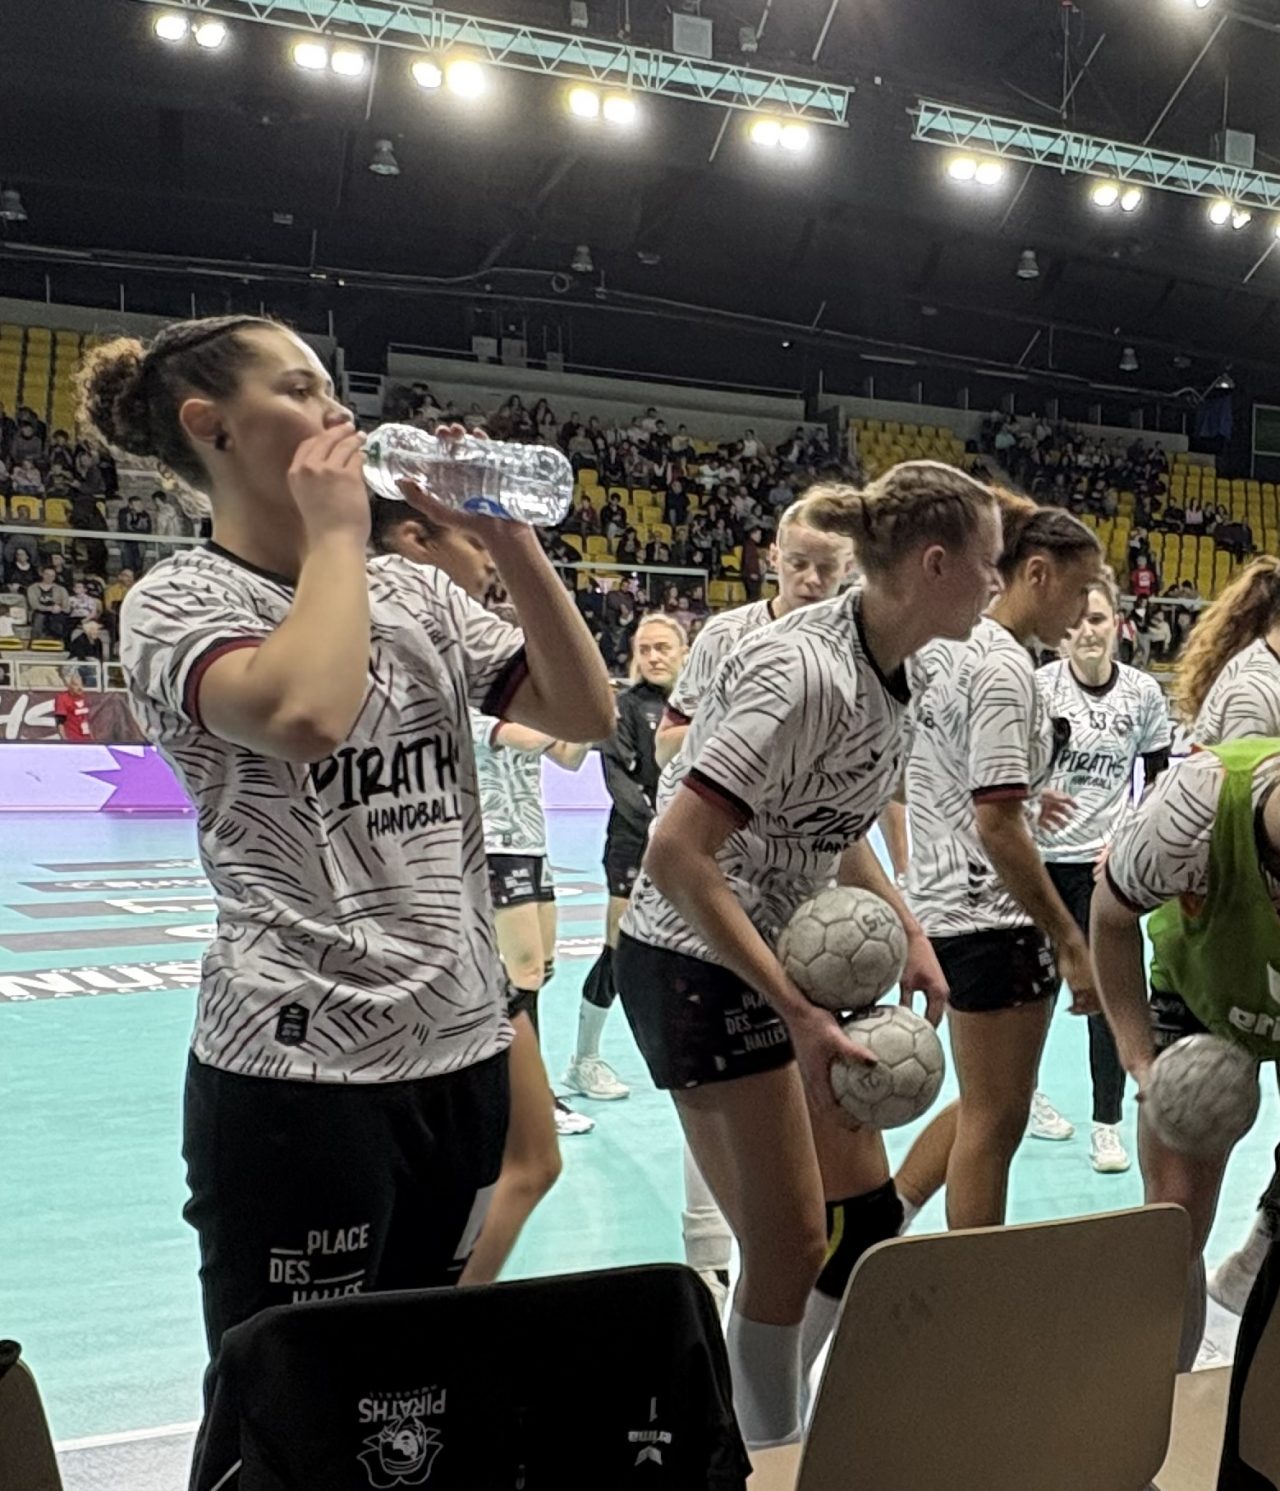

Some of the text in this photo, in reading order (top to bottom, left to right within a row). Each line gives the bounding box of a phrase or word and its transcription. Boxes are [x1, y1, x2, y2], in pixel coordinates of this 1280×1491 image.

[309, 733, 461, 810] PIRATH
[1059, 749, 1128, 778] PIRATHS
[367, 793, 462, 841] HANDBALL
[307, 1223, 371, 1255] PLACE
[269, 1257, 310, 1285] DES
[358, 1388, 447, 1424] PIRATHS
